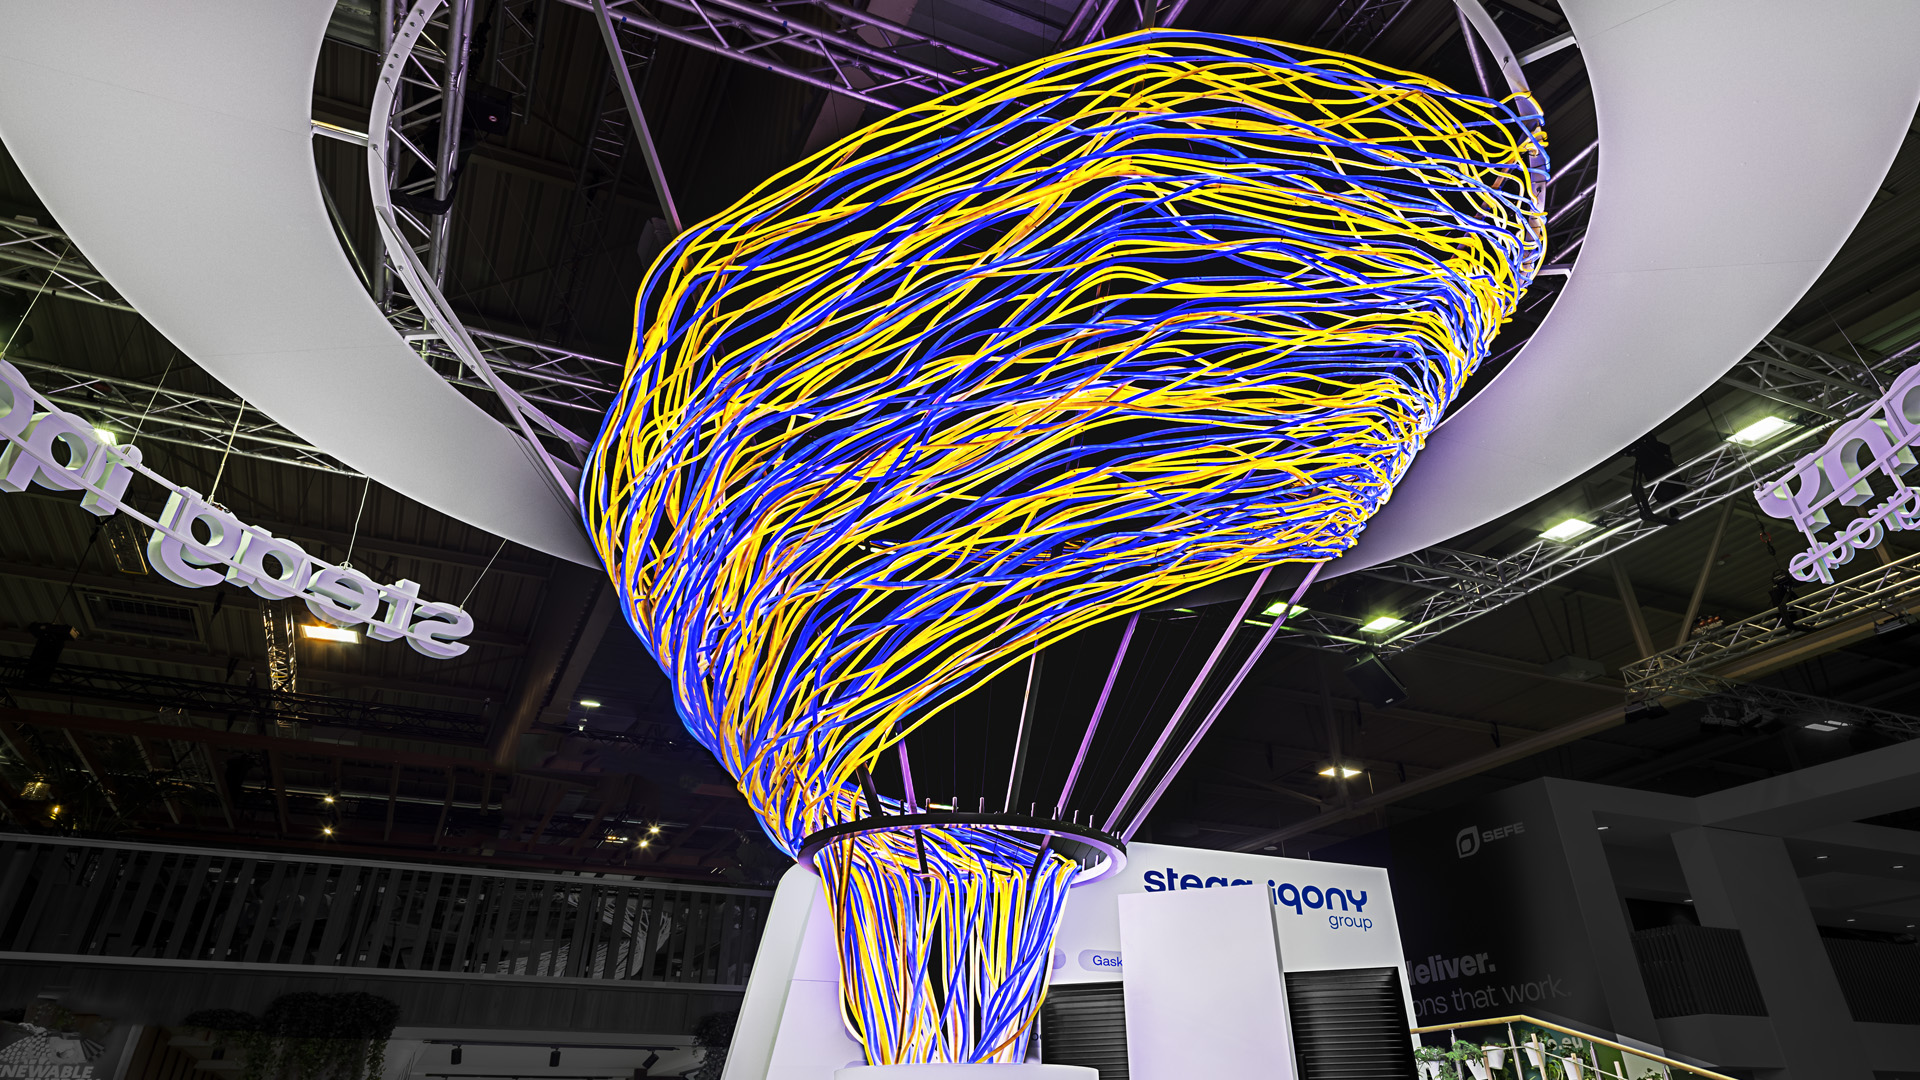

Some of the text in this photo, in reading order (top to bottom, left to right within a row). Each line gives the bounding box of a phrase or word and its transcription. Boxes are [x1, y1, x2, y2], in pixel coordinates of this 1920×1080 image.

[1482, 822, 1526, 843] SEFE
[1144, 867, 1368, 915] ste iqony
[1328, 915, 1373, 932] group
[1451, 984, 1500, 1012] that
[1501, 973, 1573, 1007] work.
[0, 1064, 94, 1078] NEWABLE
